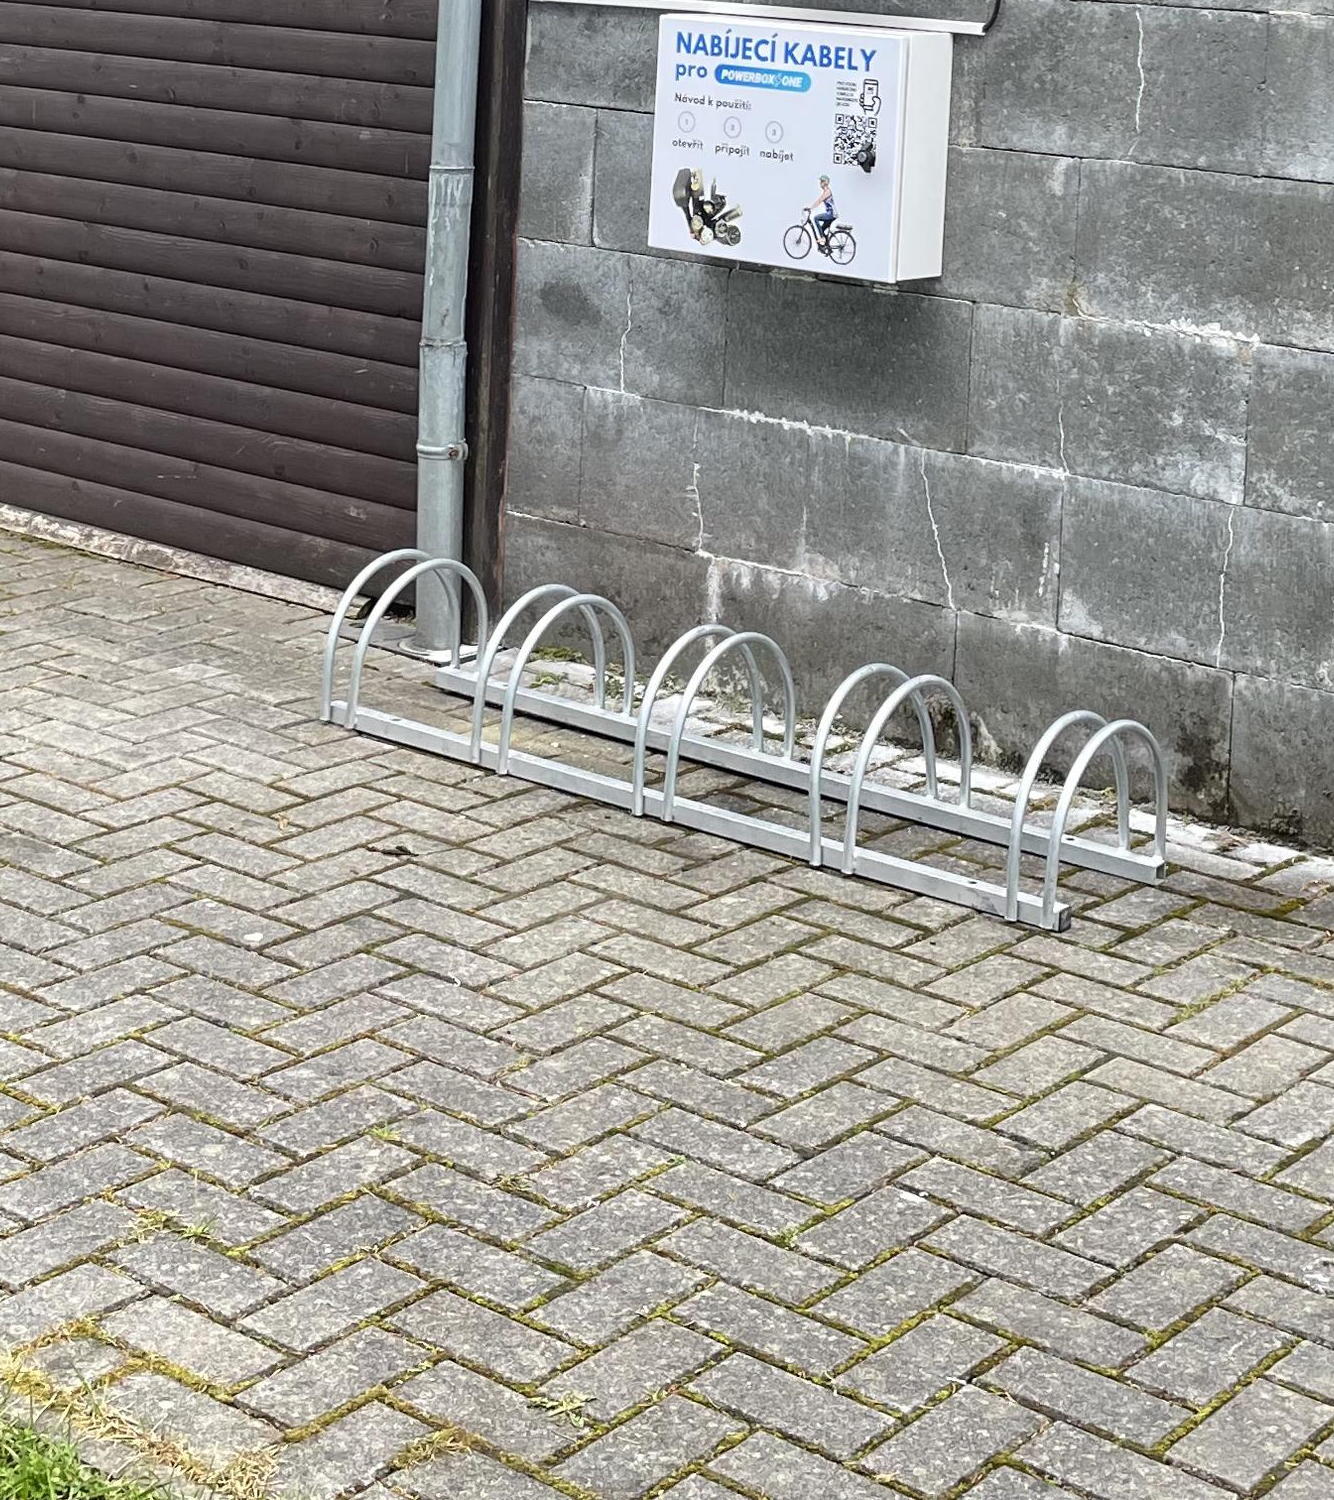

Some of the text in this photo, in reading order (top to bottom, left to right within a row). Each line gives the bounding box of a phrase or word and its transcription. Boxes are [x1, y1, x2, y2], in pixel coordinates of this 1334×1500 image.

[675, 28, 877, 73] NABÍJECÍ KABELY
[675, 63, 803, 88] pro POWERBOX ONE
[674, 92, 705, 106] Návod
[708, 95, 713, 106] k
[760, 149, 794, 163] nabíjet
